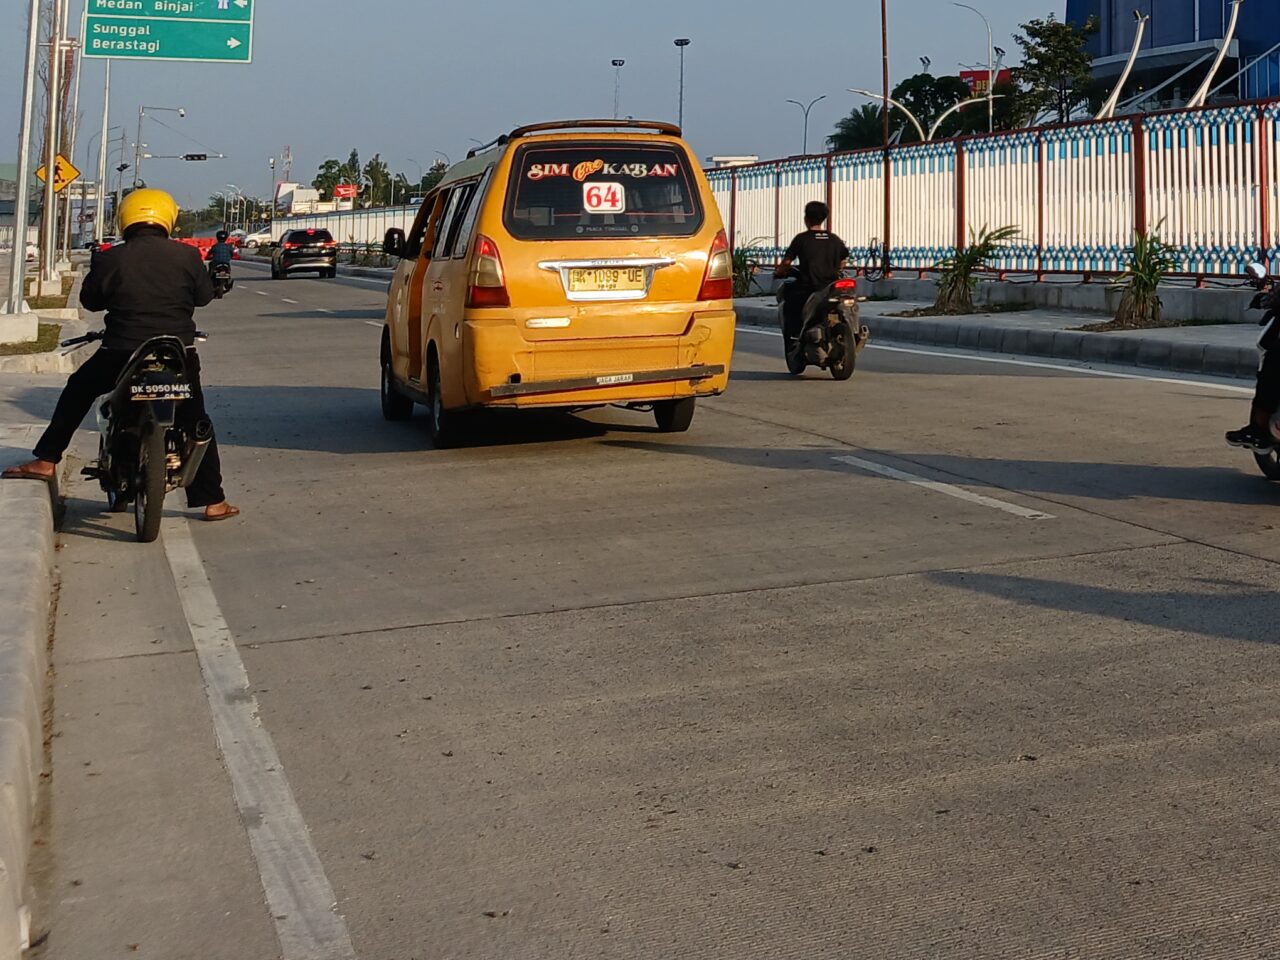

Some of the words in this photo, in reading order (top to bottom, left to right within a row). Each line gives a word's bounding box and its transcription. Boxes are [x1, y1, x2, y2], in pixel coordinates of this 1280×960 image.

[154, 0, 194, 14] Binjai
[93, 23, 151, 37] Sunggal
[92, 39, 161, 52] Berastagi
[527, 163, 570, 180] SIM
[603, 163, 678, 180] KABAN
[586, 184, 619, 208] 64
[627, 269, 642, 283] UE
[145, 385, 170, 393] 5050
